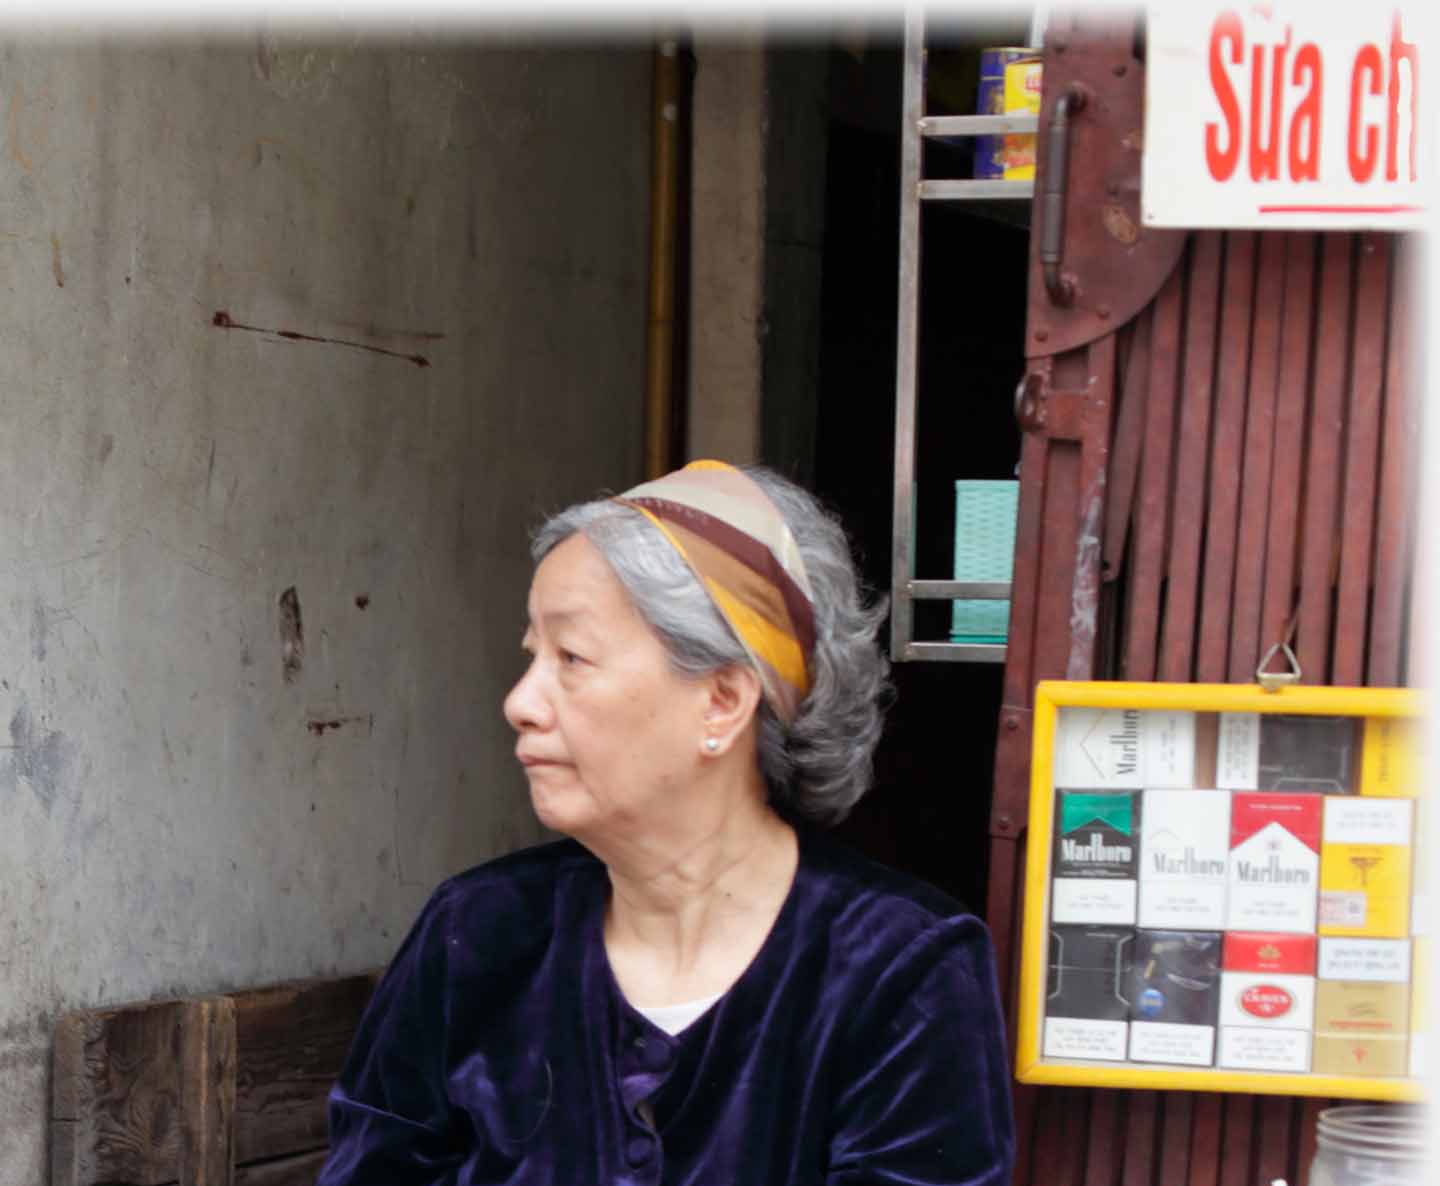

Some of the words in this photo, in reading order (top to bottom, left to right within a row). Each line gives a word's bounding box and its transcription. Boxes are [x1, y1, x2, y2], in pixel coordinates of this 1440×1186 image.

[1061, 832, 1133, 861] Marlboro
[1153, 848, 1225, 876] Marlboro
[1237, 855, 1310, 885] Marlboro
